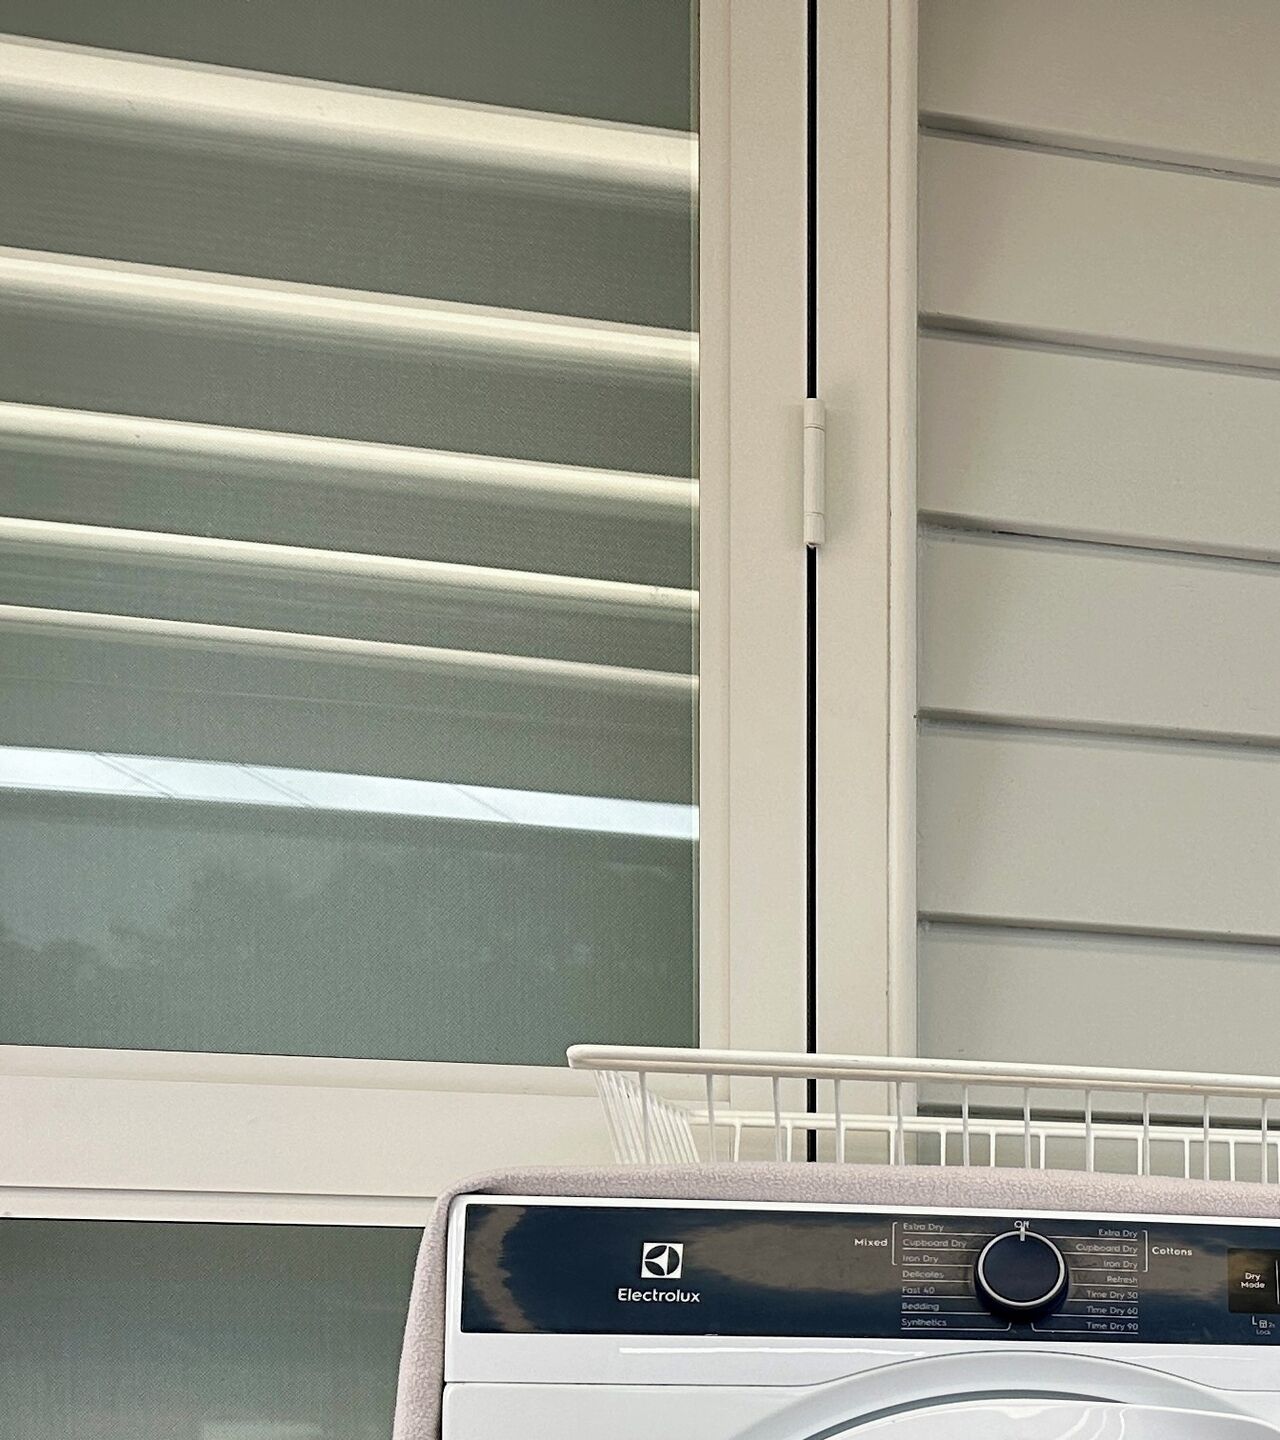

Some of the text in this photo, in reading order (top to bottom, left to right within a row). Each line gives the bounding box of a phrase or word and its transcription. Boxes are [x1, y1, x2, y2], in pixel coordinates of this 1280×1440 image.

[903, 1223, 944, 1232] Extra Dry
[1098, 1229, 1138, 1239] Extra Dry
[854, 1238, 888, 1247] Mixed
[902, 1239, 967, 1248] Cupboard Dry
[1075, 1243, 1138, 1254] Cupboard Dry
[1152, 1246, 1193, 1256] Cottons
[923, 1255, 939, 1263] Dry
[1103, 1260, 1138, 1269] Iron Dry
[902, 1270, 945, 1279] Delicates
[1245, 1272, 1261, 1281] Dry
[1106, 1275, 1138, 1284] Refresh
[1240, 1281, 1266, 1289] Mode
[902, 1286, 936, 1294] Fast 40
[618, 1288, 700, 1303] Electrolux
[1086, 1290, 1138, 1300] Time Dry 30
[902, 1302, 940, 1312] Bedding
[1086, 1305, 1138, 1316] Time Dry 60
[902, 1318, 947, 1327] Synthetics
[1086, 1321, 1138, 1332] Time Dry 90
